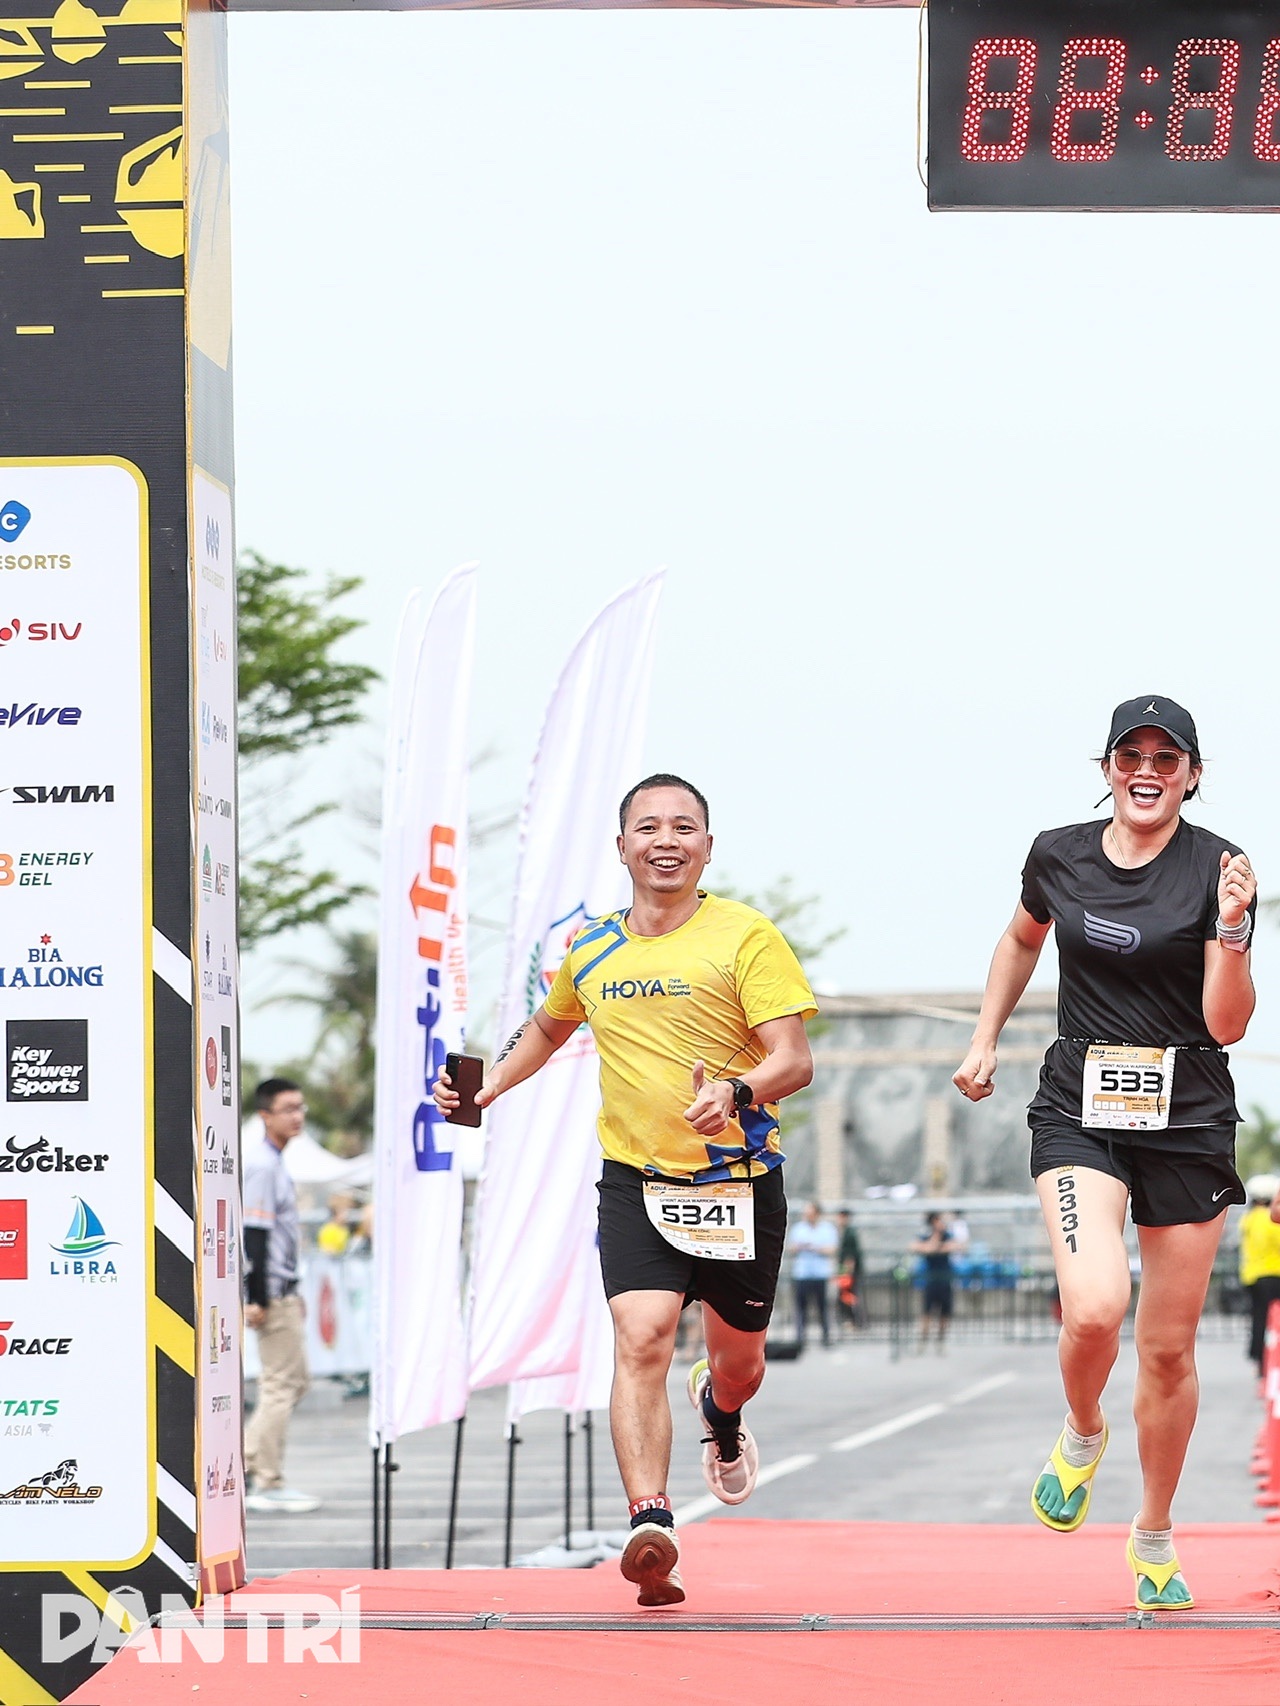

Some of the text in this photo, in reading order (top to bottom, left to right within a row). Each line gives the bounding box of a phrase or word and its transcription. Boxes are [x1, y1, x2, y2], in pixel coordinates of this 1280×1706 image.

[28, 623, 82, 640] SIV
[13, 785, 114, 803] SWIM
[19, 852, 94, 865] ENERGY
[19, 872, 53, 885] GEL
[28, 949, 63, 962] BIA
[600, 979, 667, 1000] HOYA
[11, 1046, 53, 1065] Key
[11, 1064, 83, 1078] Power
[11, 1078, 81, 1097] Sports
[661, 1204, 735, 1226] 5341
[1057, 1175, 1078, 1254] 5331
[81, 1275, 118, 1283] TECH
[0, 1400, 60, 1416] TATS
[5, 1425, 33, 1437] ASIA
